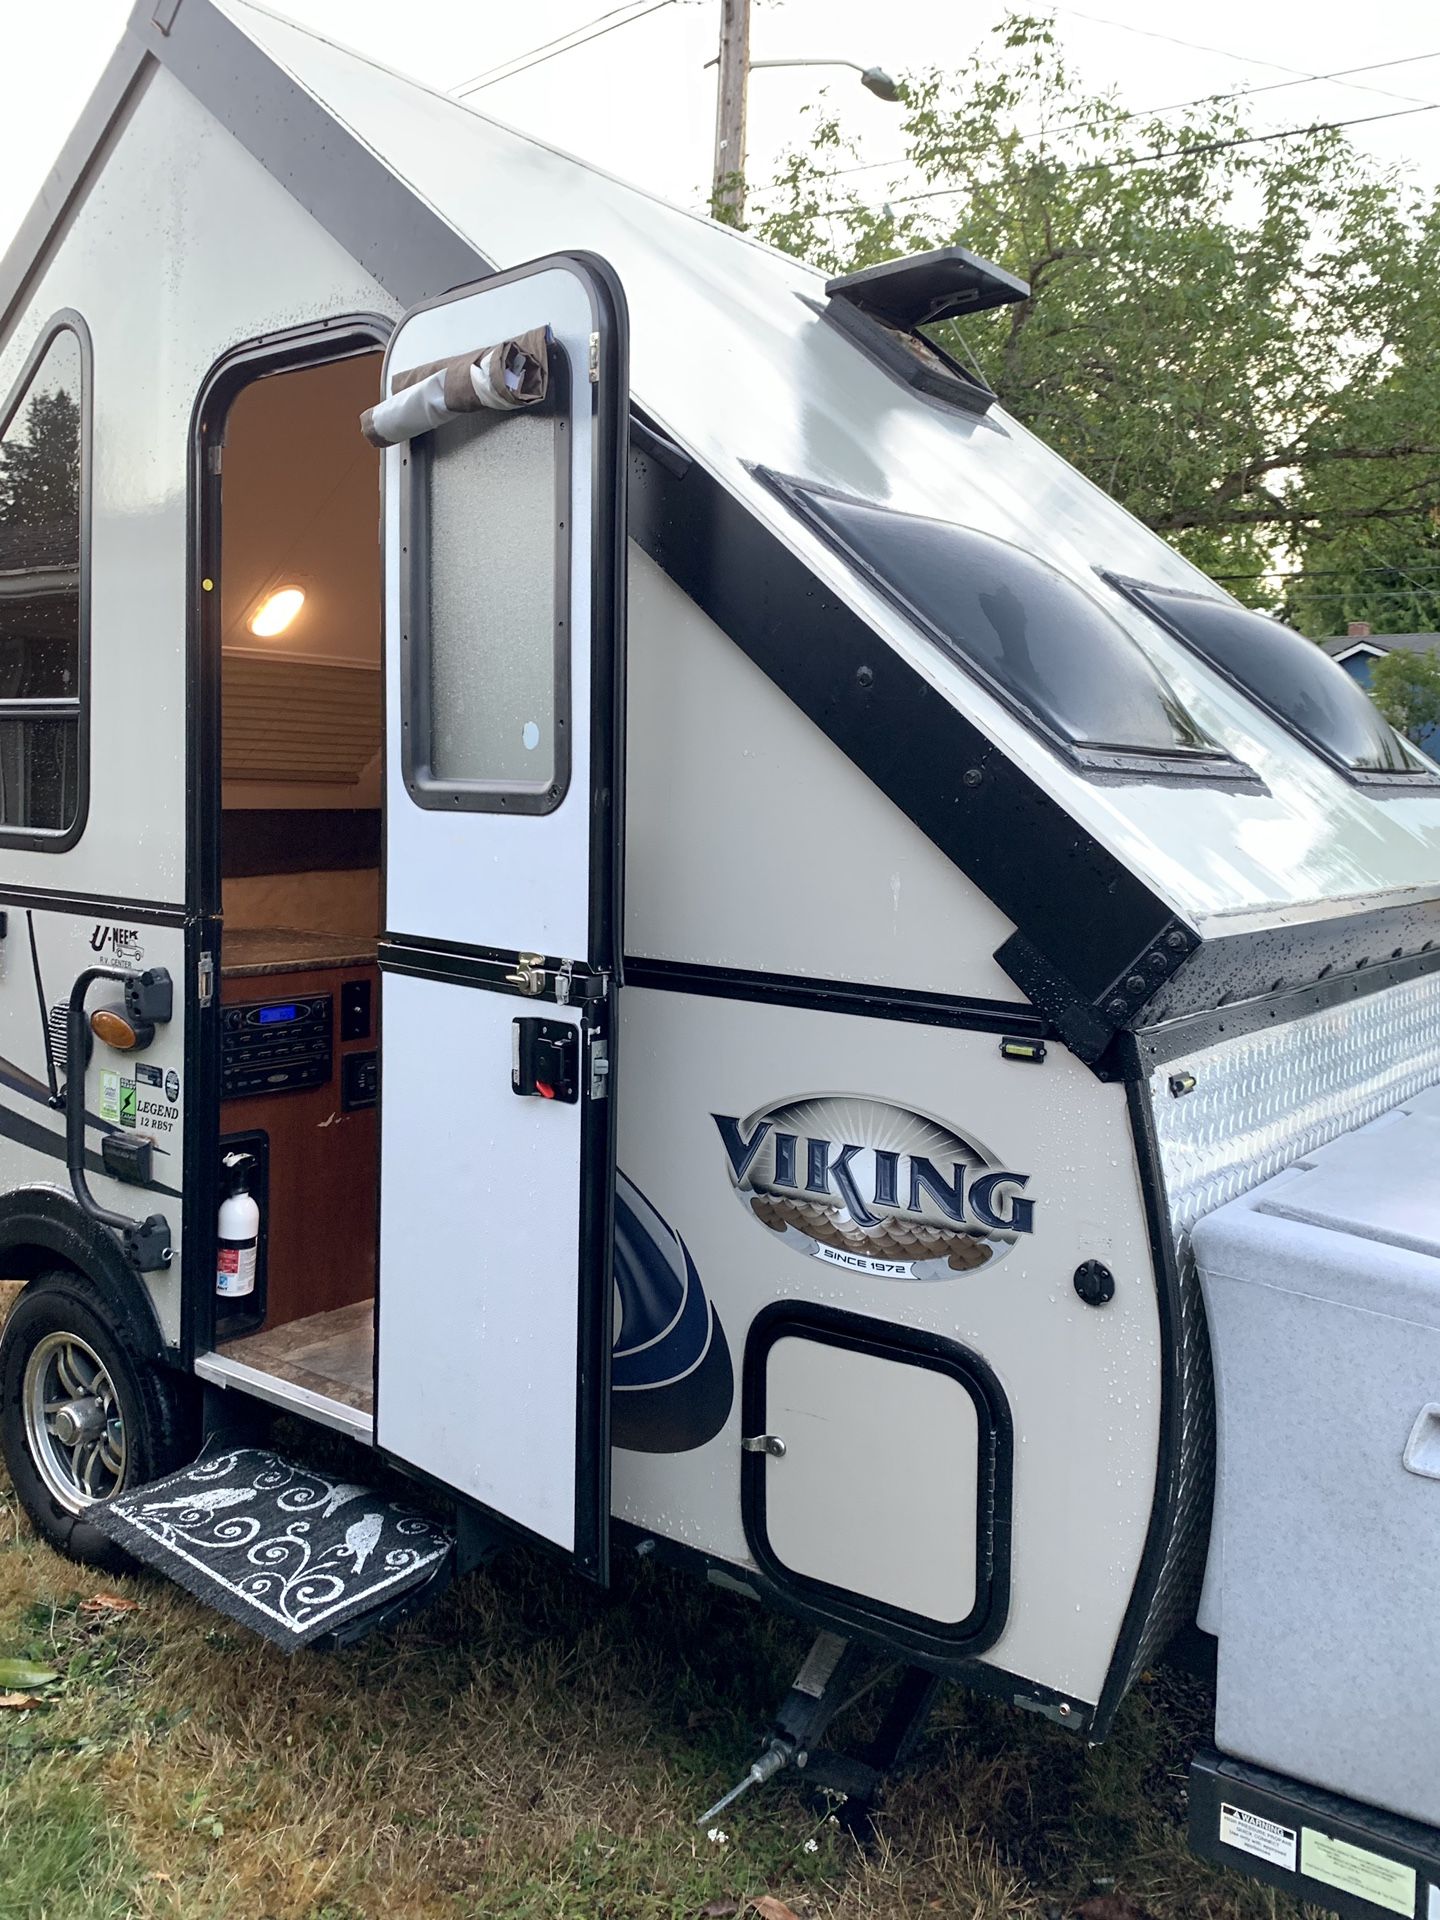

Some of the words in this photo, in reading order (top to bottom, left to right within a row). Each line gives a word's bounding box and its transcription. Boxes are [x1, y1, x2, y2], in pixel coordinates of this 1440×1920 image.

[137, 1100, 179, 1120] LEGEND
[140, 1117, 149, 1127] 12
[151, 1119, 174, 1133] RBST
[709, 1112, 1036, 1234] VIKING
[823, 1249, 867, 1268] SINCE
[870, 1262, 906, 1274] 1972
[1241, 1813, 1284, 1837] WARNING
